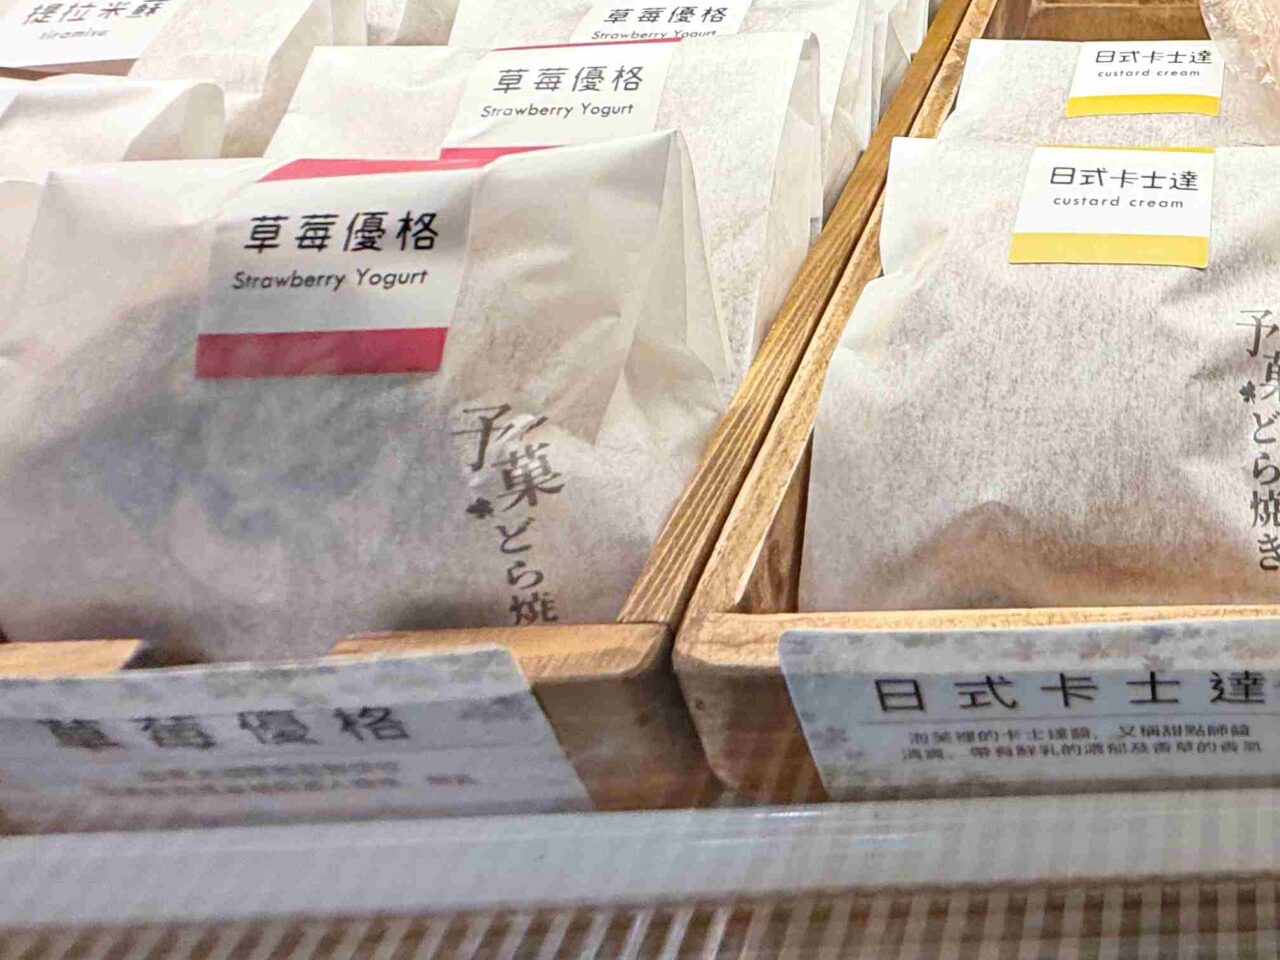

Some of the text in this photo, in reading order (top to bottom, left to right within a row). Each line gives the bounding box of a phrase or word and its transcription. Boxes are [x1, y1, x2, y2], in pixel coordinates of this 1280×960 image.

[23, 0, 171, 25] 提拉米蘇
[602, 6, 729, 23] 草莓優格
[39, 29, 108, 40] tiramisu
[591, 30, 668, 40] Strawberry
[1095, 50, 1212, 64] 日式卡士達
[493, 65, 645, 94] 草莓優格
[1098, 69, 1150, 77] custard
[480, 103, 634, 118] Strawberry Yogurt
[1050, 167, 1199, 191] 日式卡士達
[1053, 196, 1184, 208] custard cream
[244, 210, 438, 253] 草莓優格
[233, 268, 428, 291] Strawberry Yogurt
[874, 670, 1267, 713] 日式卡士達
